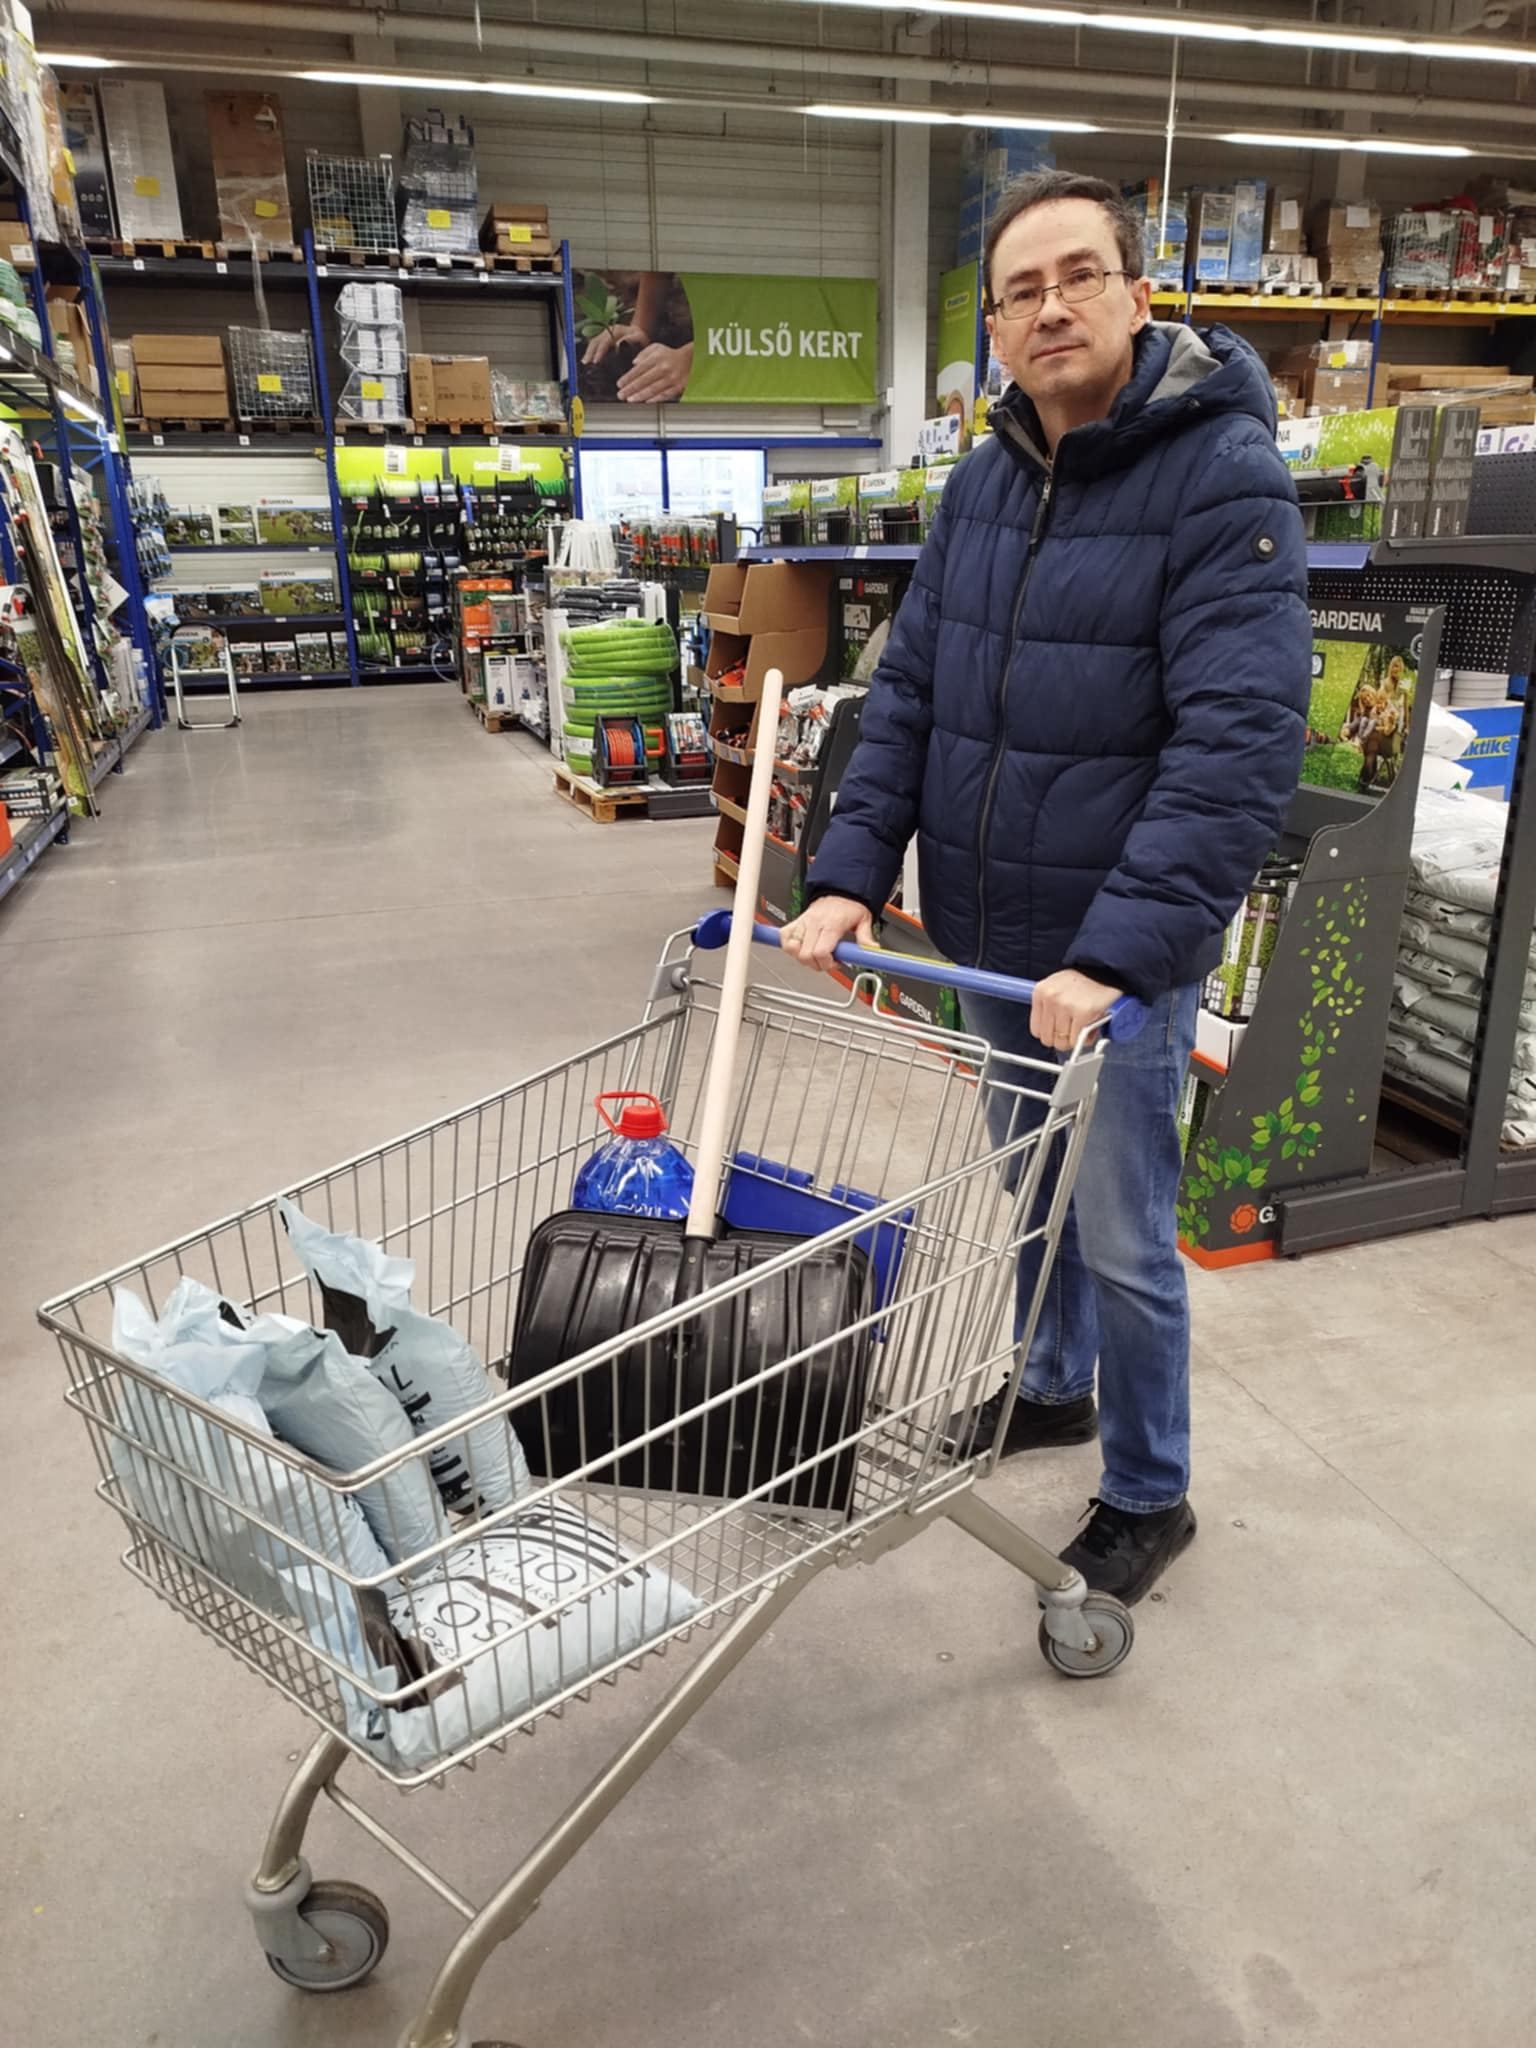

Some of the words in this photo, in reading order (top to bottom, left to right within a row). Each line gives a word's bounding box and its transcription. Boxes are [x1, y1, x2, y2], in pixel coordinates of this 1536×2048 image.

[708, 322, 793, 357] KÜLSŐ
[799, 330, 863, 359] KERT
[1310, 609, 1383, 633] GARDENA
[899, 991, 932, 1024] GARDENA
